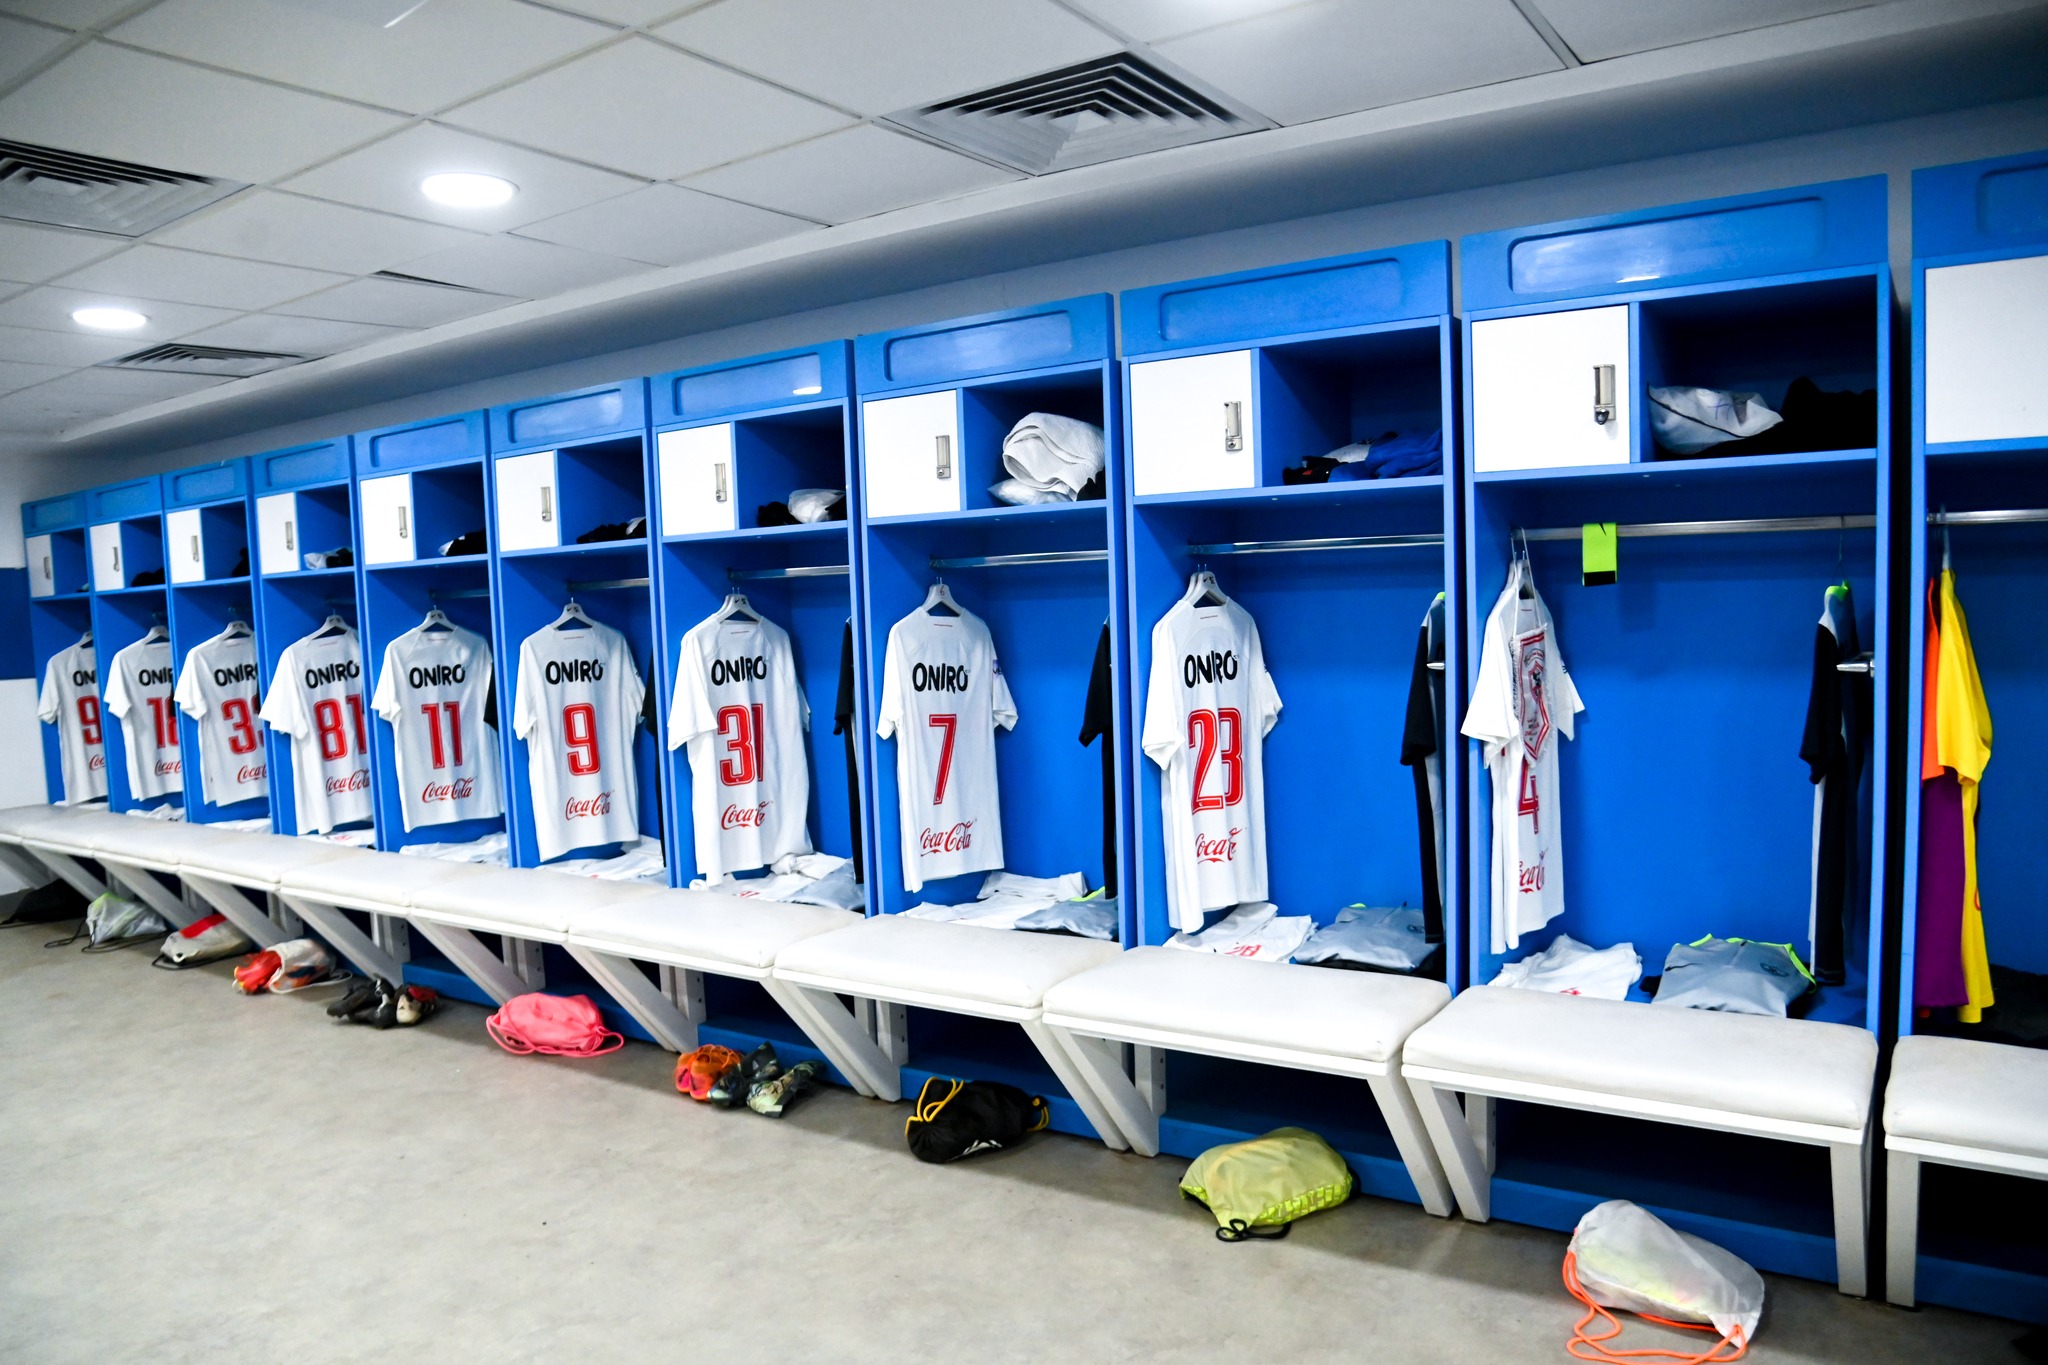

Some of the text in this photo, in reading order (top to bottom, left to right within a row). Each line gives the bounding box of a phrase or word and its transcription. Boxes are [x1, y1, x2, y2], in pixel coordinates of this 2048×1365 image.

[305, 660, 360, 689] ONIRO
[409, 664, 466, 689] ONIRO
[545, 659, 603, 685] ONIRO
[711, 656, 767, 686] ONIRO
[912, 662, 967, 694] ONIRO
[1184, 650, 1239, 689] ONIRO
[313, 693, 367, 762] 81
[421, 701, 462, 769] 11
[563, 703, 601, 776] 9
[717, 703, 764, 787] 31
[929, 714, 957, 805] 7
[1188, 707, 1243, 815] 23
[325, 769, 370, 797] Coca-Cola
[422, 776, 475, 803] Coca-Cola
[721, 801, 769, 830] Coca-Ca
[920, 820, 973, 857] Coca-Cola
